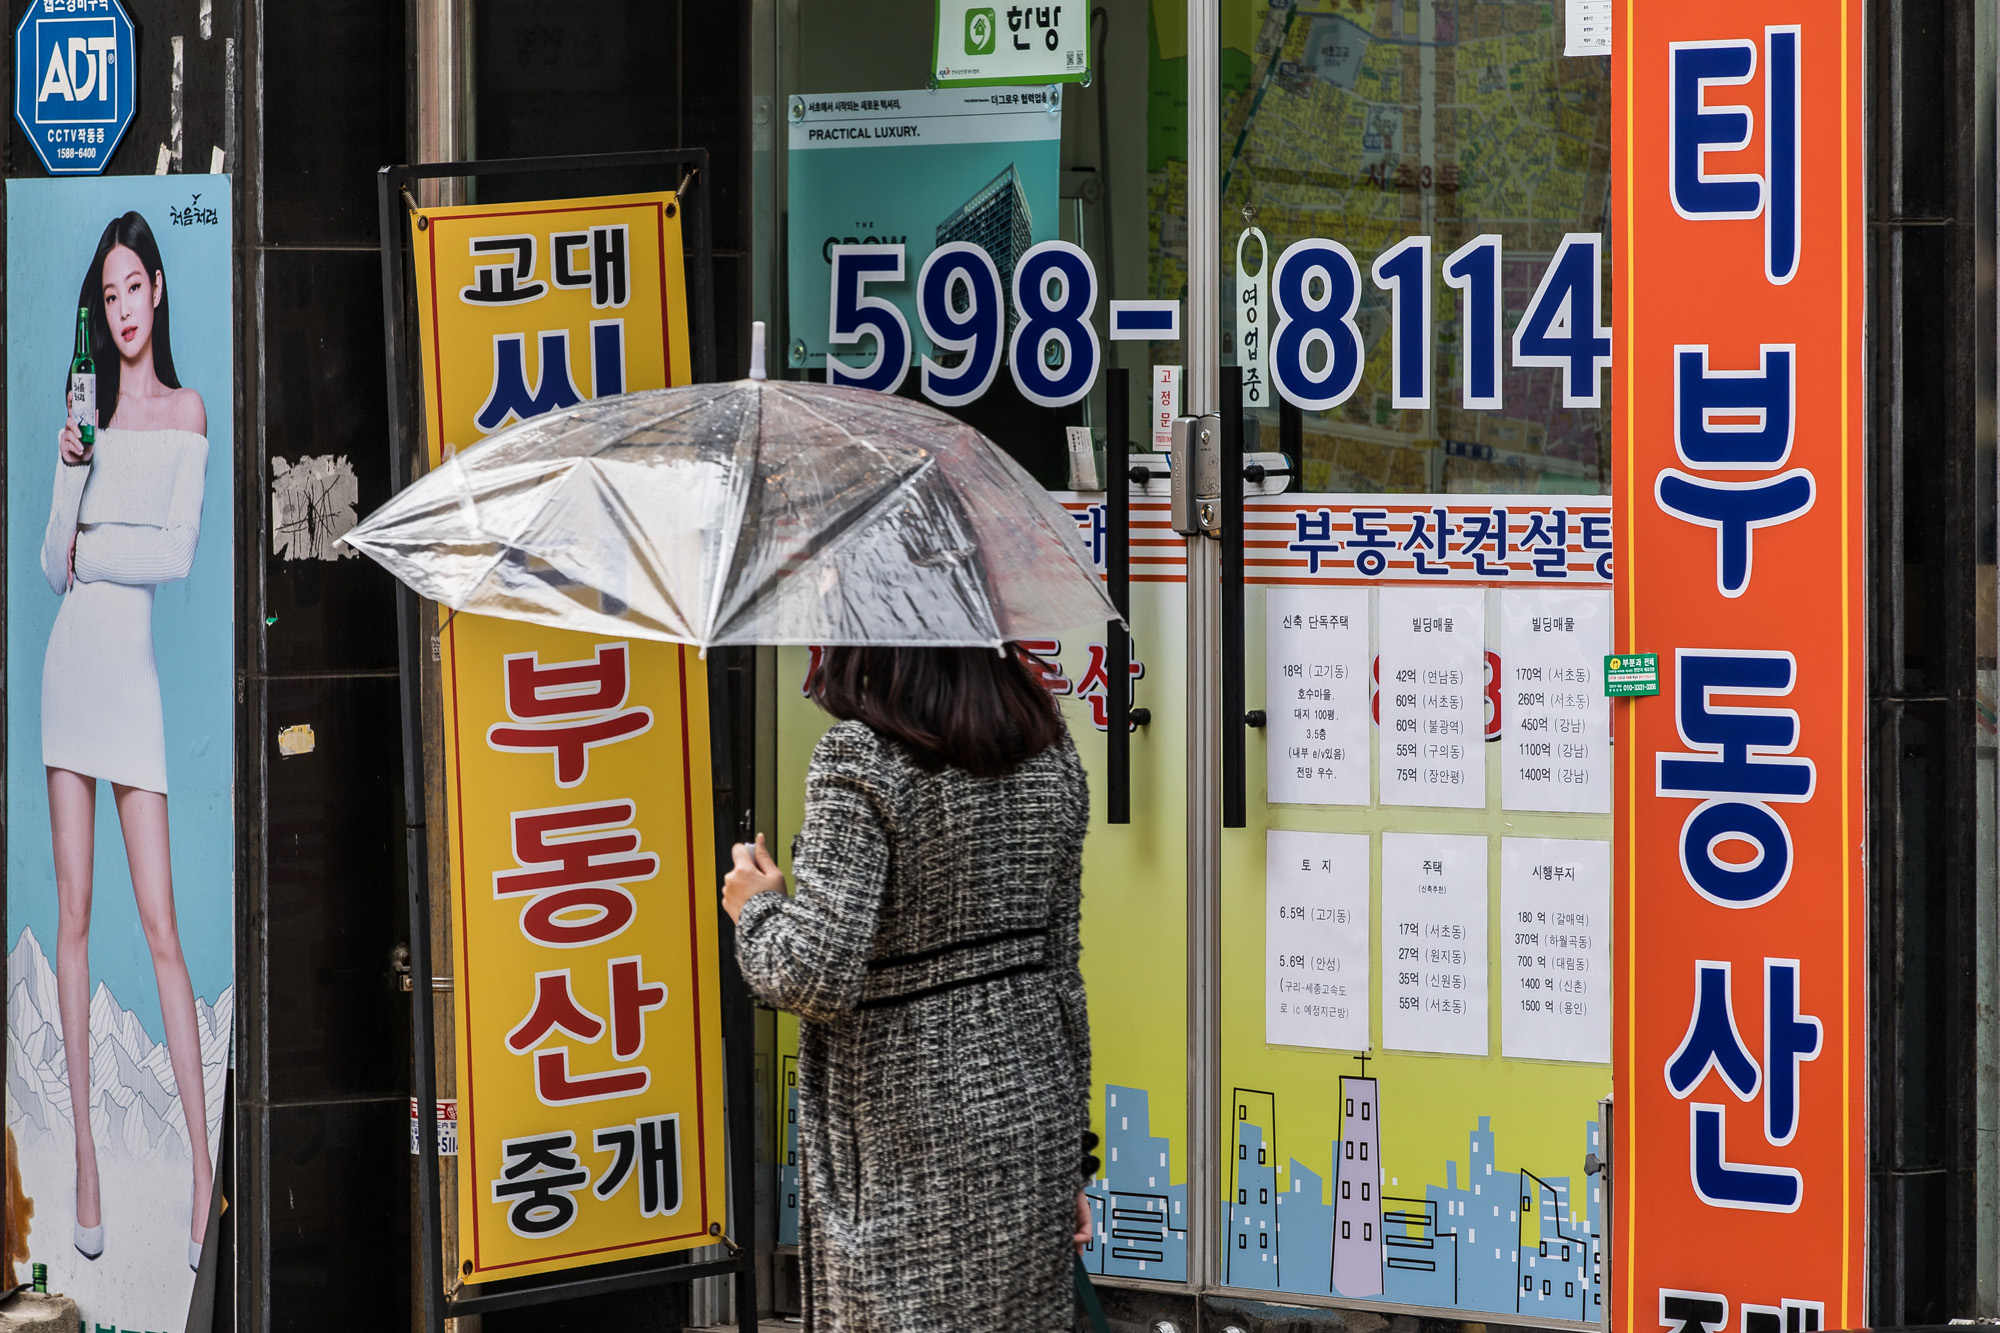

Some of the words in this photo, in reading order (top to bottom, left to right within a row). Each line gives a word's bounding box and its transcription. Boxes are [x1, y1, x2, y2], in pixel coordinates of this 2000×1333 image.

[1007, 5, 1061, 51] 한방
[38, 37, 115, 102] ADT
[47, 127, 105, 144] CCTV작동중
[808, 127, 872, 141] PRACTICAL
[874, 125, 920, 138] LUXURY.
[57, 147, 96, 159] 1588-6400
[170, 205, 218, 227] 처음처럼
[855, 221, 874, 229] THE
[459, 223, 631, 309] 교대
[1243, 283, 1262, 402] 영업중
[1160, 369, 1172, 428] 고정문
[1283, 615, 1302, 629] 신축
[1309, 615, 1348, 630] 단독주택
[1413, 617, 1454, 632] 빌딩매물
[1532, 617, 1575, 632] 빌딩매물
[1283, 664, 1302, 678] 18억
[1309, 664, 1348, 679] (고기동)
[1396, 669, 1416, 683] 42억
[1423, 670, 1463, 685] (연남동)
[1516, 667, 1541, 682] 170억
[1549, 668, 1590, 683] (서초동)
[1298, 688, 1334, 701] 호수마을.
[1396, 694, 1416, 708] 60억
[1423, 695, 1463, 710] (서초동)
[1518, 692, 1544, 707] 260억
[1551, 693, 1589, 709] (서초동)
[1294, 708, 1309, 720] 대지
[1315, 709, 1338, 720] 100평.
[1396, 718, 1416, 733] 60억
[1423, 719, 1463, 735] (불광역)
[1521, 717, 1547, 732] 450억
[1555, 718, 1585, 734] (강남)
[1307, 728, 1326, 740] 3.5층
[1289, 747, 1308, 759] (내부
[1313, 748, 1345, 760] e/v있음)
[1397, 743, 1416, 757] 55억
[1424, 744, 1464, 760] (구의동)
[1519, 742, 1550, 757] 1100억
[1558, 743, 1588, 759] (강남)
[1297, 767, 1313, 778] 전망
[1317, 768, 1336, 779] 우수.
[1397, 768, 1417, 782] 75억
[1424, 769, 1464, 785] (장안평)
[1520, 768, 1550, 782] 1400억
[1558, 768, 1588, 784] (강남)
[486, 641, 668, 1107] 부동산
[1423, 861, 1442, 876] 주택
[1532, 865, 1574, 881] 시행부지
[1419, 885, 1446, 894] (신축추천)
[1280, 906, 1304, 920] 6.5억
[1311, 907, 1350, 924] (고기동)
[1552, 912, 1588, 927] (갈매역)
[1399, 922, 1418, 937] 17억
[1425, 923, 1466, 940] (서초동)
[1515, 933, 1538, 946] 370억
[1545, 934, 1591, 949] (하월곡동)
[1280, 955, 1304, 969] 5.6억
[1311, 956, 1340, 972] (안성)
[1399, 947, 1418, 961] 27억
[1425, 948, 1466, 965] (원지동)
[1552, 957, 1589, 972] (대림동)
[1399, 972, 1419, 986] 35억
[1426, 973, 1466, 990] (신원동)
[1559, 979, 1586, 993] (신촌)
[1280, 1003, 1287, 1013] 로
[1304, 1005, 1348, 1019] 예정지근방)
[1399, 997, 1419, 1011] 55억
[1426, 998, 1466, 1015] (서초동)
[1560, 1001, 1586, 1016] (용인)
[492, 1112, 683, 1239] 중개
